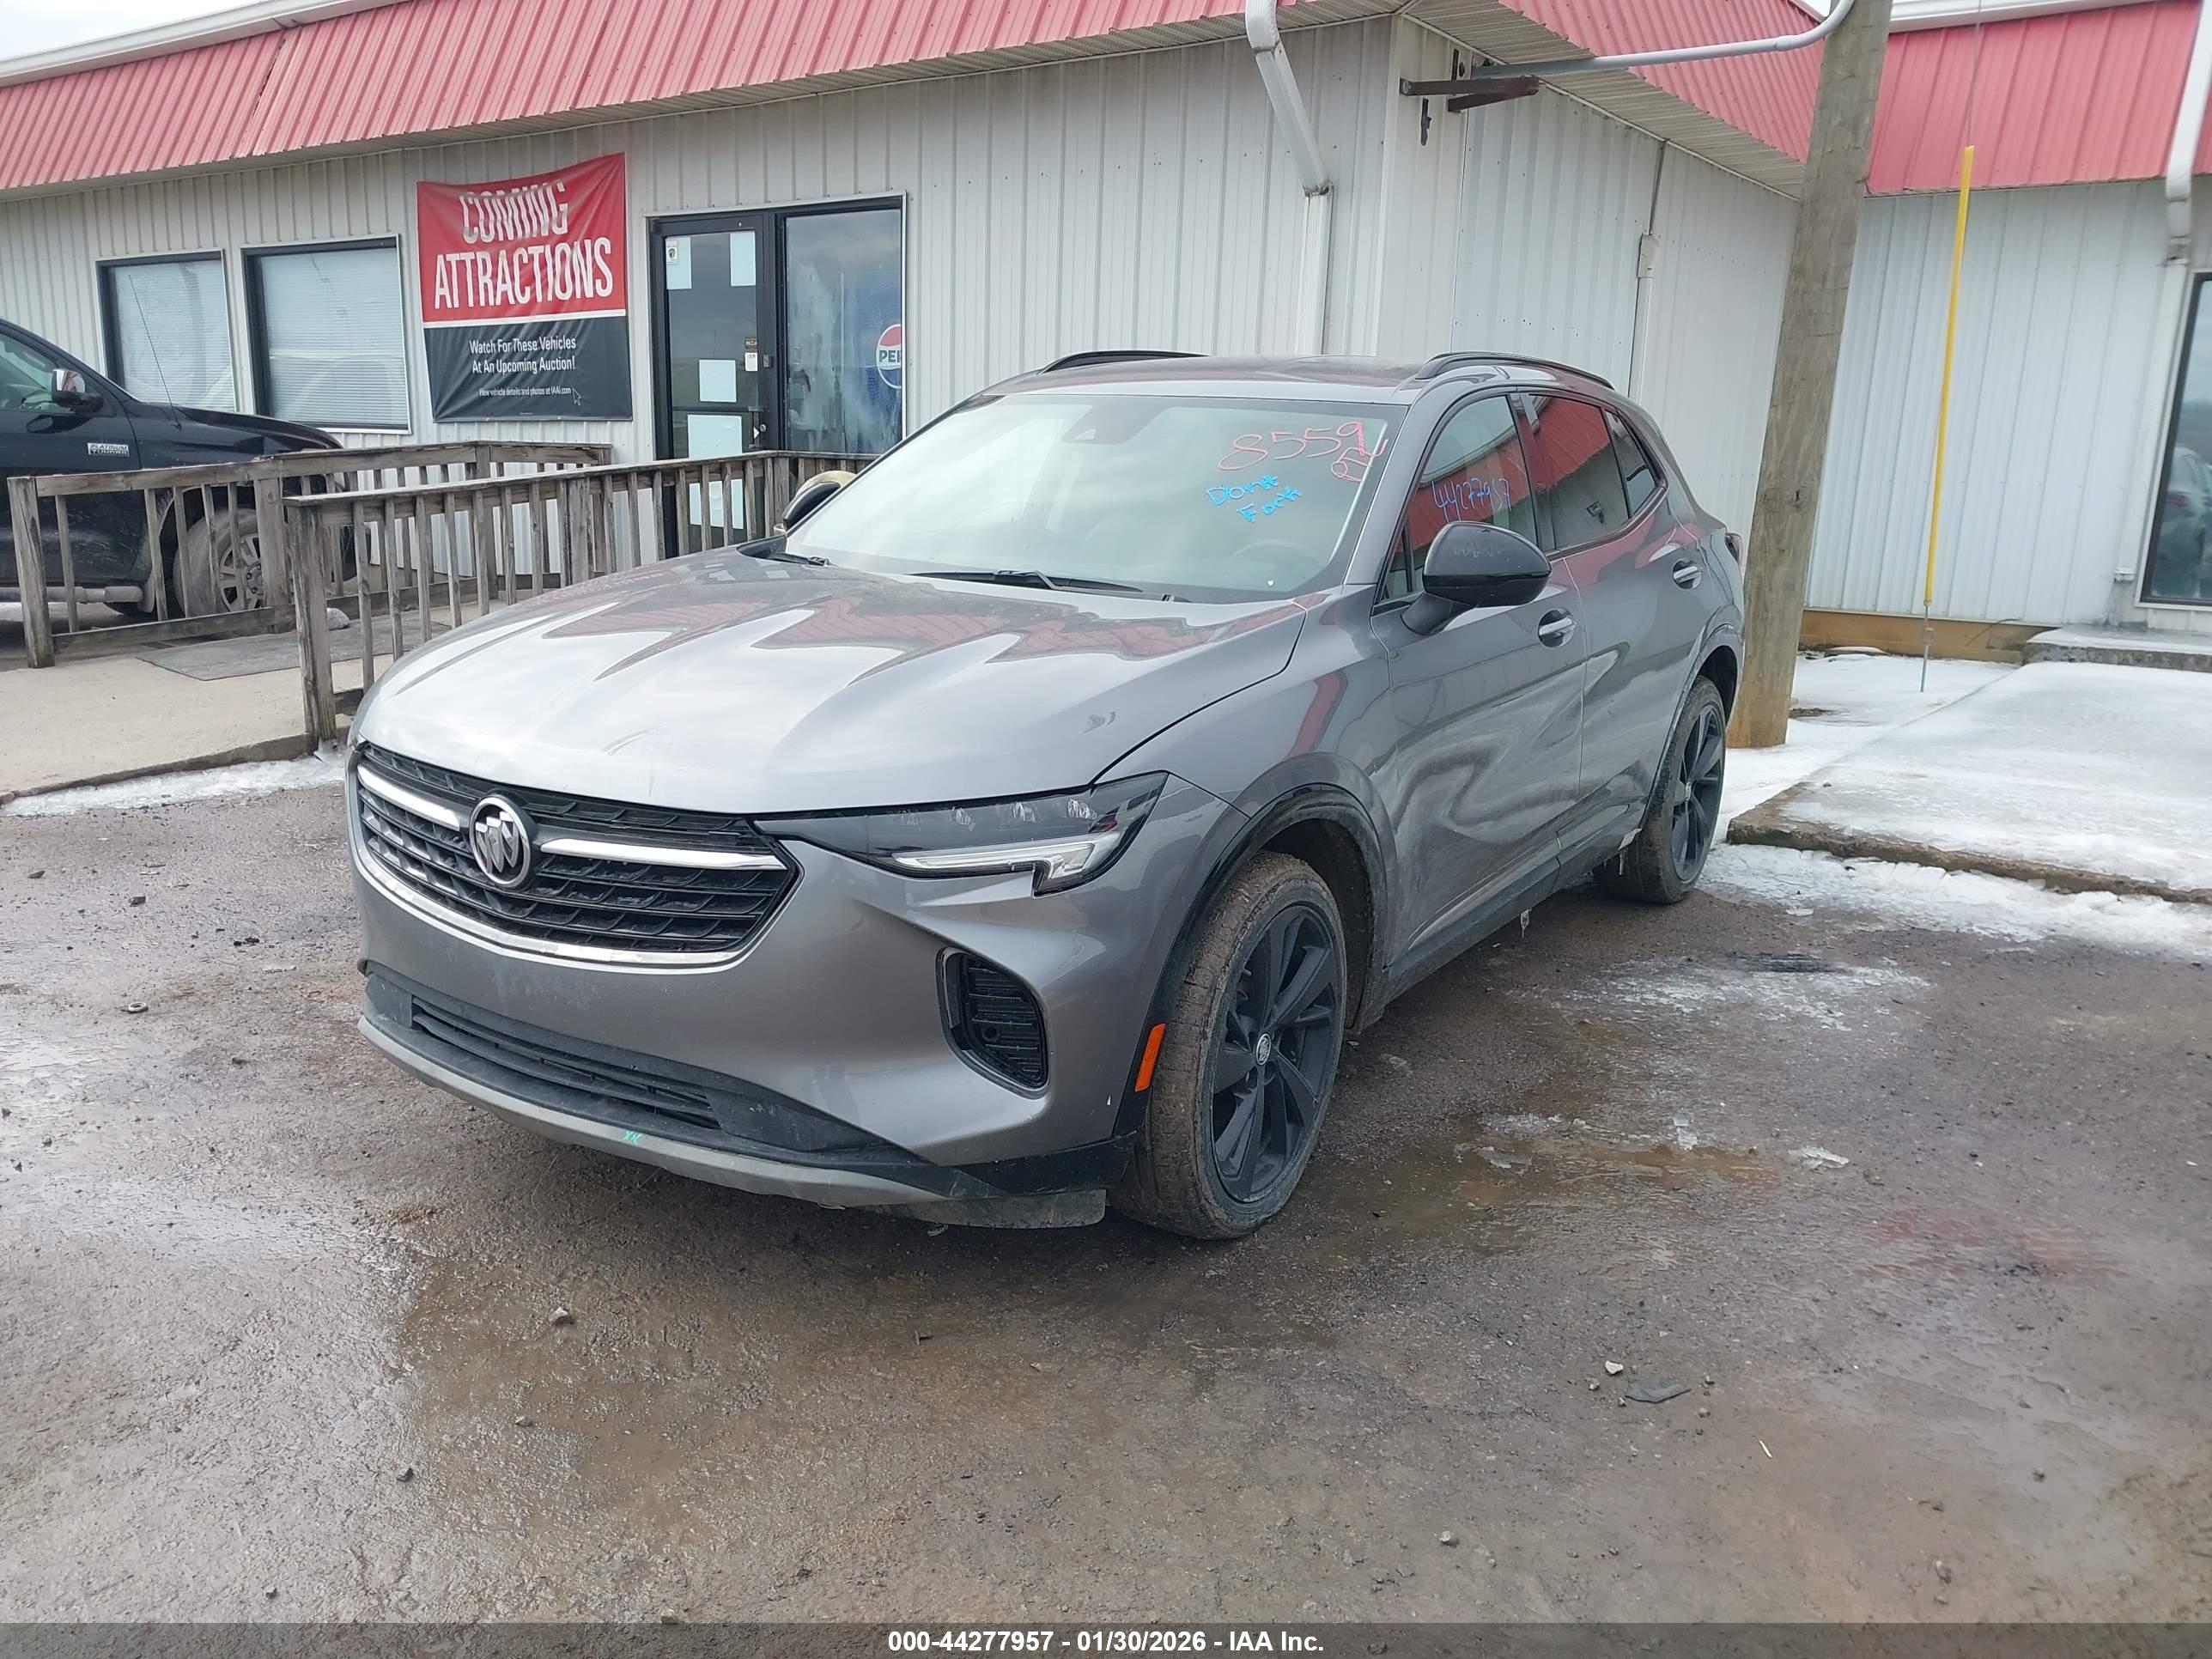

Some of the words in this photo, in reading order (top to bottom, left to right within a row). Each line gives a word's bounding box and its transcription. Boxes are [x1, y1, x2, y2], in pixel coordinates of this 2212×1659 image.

[459, 179, 568, 245] COMING
[434, 236, 613, 309] ATTRACTIONS
[470, 339, 496, 354] Watch
[498, 338, 512, 353] For
[513, 337, 538, 352] These
[539, 334, 576, 350] Vehicles
[472, 360, 482, 374] At
[483, 359, 495, 374] An
[496, 357, 537, 376] Upcoming
[539, 356, 575, 371] Auction!
[521, 386, 530, 396] and
[1218, 421, 1364, 471] 8559
